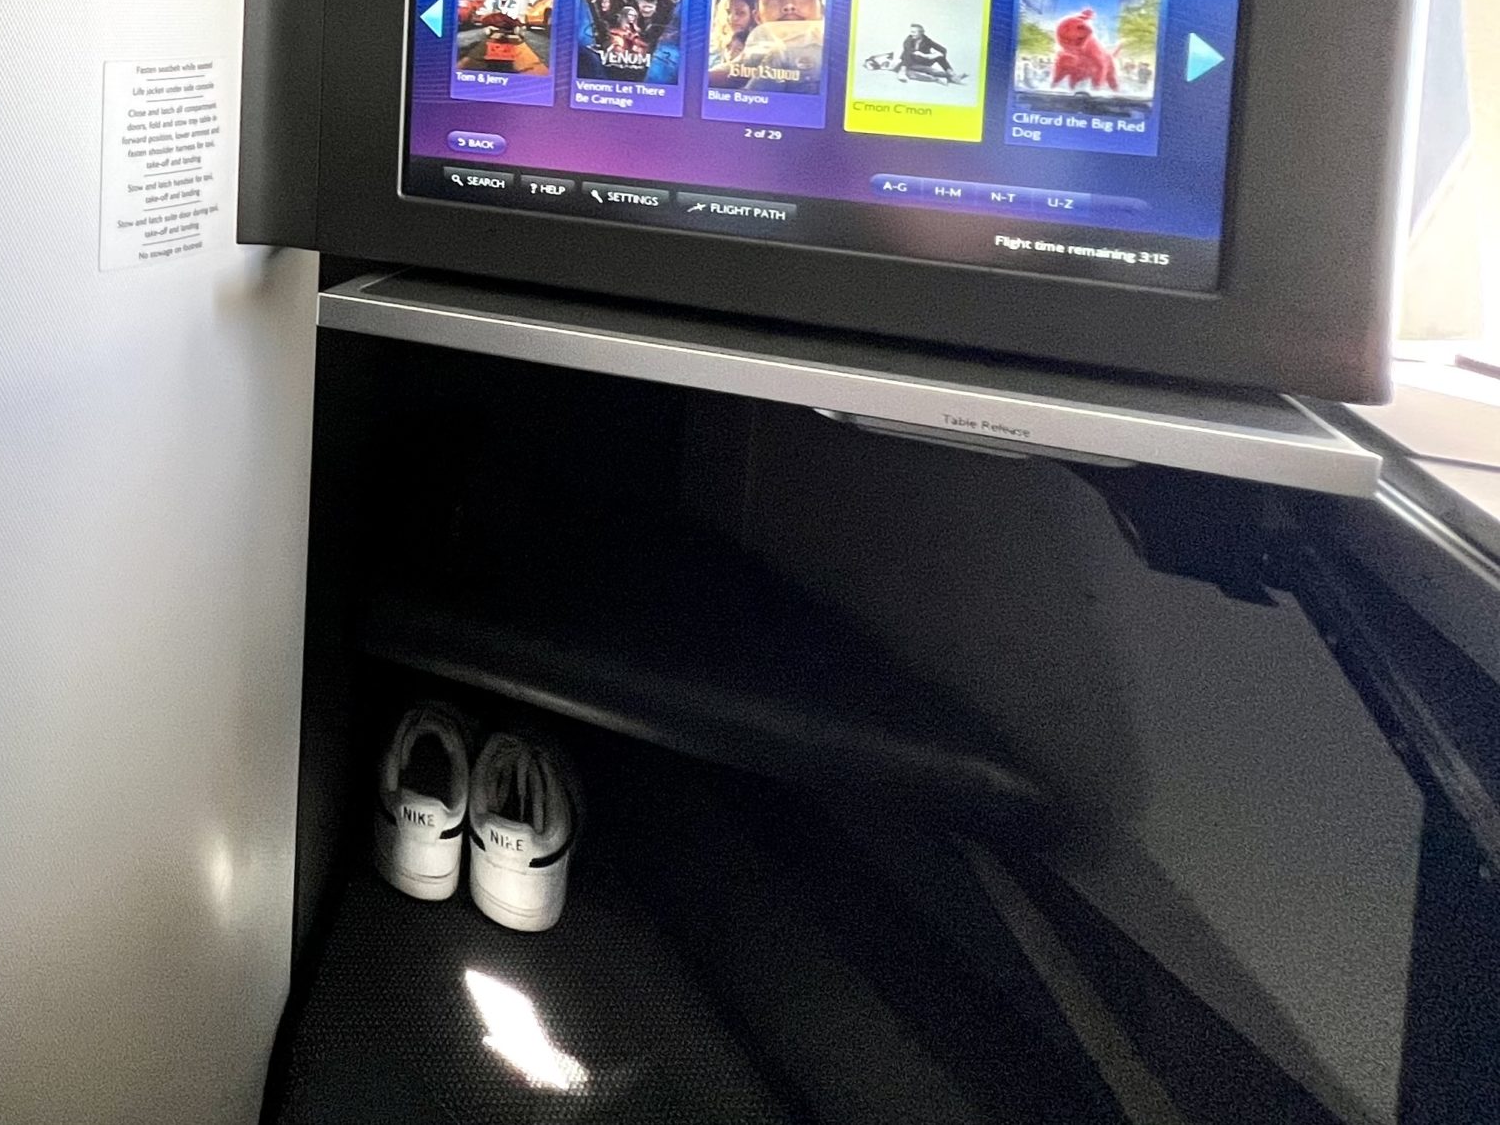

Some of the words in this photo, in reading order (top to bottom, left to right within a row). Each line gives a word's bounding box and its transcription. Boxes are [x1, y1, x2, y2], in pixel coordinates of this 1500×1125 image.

[599, 49, 651, 67] VENOM
[456, 72, 476, 83] Tom
[478, 74, 485, 83] &
[486, 74, 508, 86] Jerry
[576, 80, 613, 93] Venom:
[615, 84, 632, 94] Let
[635, 85, 666, 97] There
[575, 93, 589, 103] Be
[708, 90, 731, 101] Blue
[734, 92, 769, 105] Bayou
[852, 101, 891, 113] C'mon
[894, 104, 933, 116] C'mon
[1012, 112, 1063, 127] Clifford
[1066, 117, 1087, 128] the
[1091, 118, 1113, 133] Big
[1117, 120, 1145, 133] Red
[744, 128, 752, 138] 2
[754, 129, 765, 139] of
[767, 130, 782, 140] 29
[1012, 127, 1041, 141] Dog
[468, 139, 495, 149] BACK
[467, 176, 505, 189] SEARCH
[883, 181, 908, 193] A-G
[540, 184, 566, 196] HELP
[935, 186, 962, 198] H-M
[607, 191, 659, 207] SETTINGS
[991, 192, 1016, 203] N-T
[1047, 197, 1074, 209] U-Z
[710, 203, 751, 217] FLIGHT
[753, 208, 786, 221] PATH
[995, 235, 1031, 251] Flight
[1034, 240, 1066, 253] time
[1068, 244, 1136, 264] remaining
[1139, 252, 1169, 265] 3:15
[942, 414, 977, 429] Table
[981, 420, 1031, 438] Release
[403, 806, 436, 827] NIKE
[490, 829, 524, 852] NIKE
